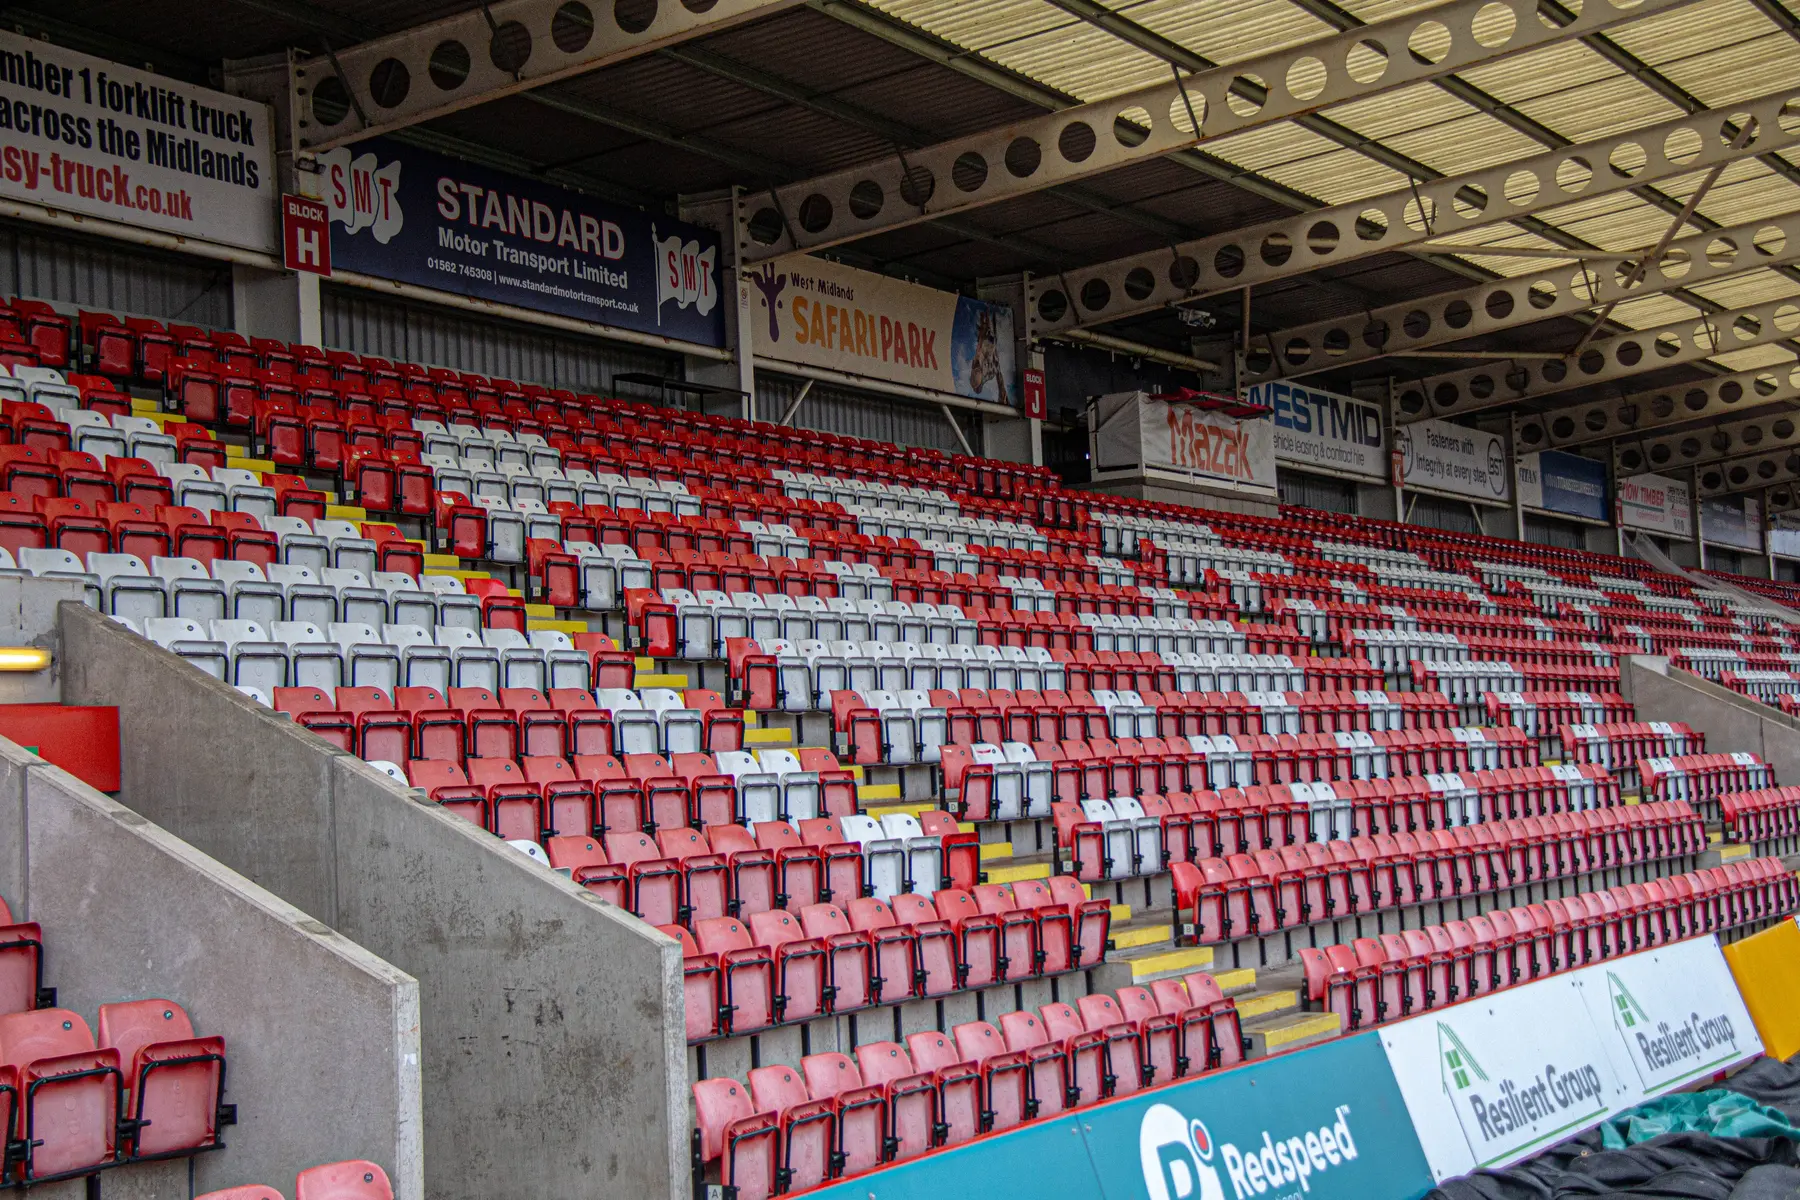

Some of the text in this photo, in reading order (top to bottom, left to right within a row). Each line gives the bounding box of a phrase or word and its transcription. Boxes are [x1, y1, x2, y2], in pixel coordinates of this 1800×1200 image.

[79, 67, 92, 104] 1
[97, 72, 186, 130] forklift
[190, 100, 254, 146] truck
[0, 96, 260, 189] across the Midlands
[0, 145, 193, 220] sy-truck.co.uk
[331, 164, 392, 220] SMT
[289, 202, 324, 222] BLOCK
[436, 176, 625, 260] STANDARD
[298, 227, 320, 267] H
[438, 226, 628, 290] Motor Transport Limited
[668, 250, 710, 296] SMT
[428, 257, 456, 274] 01562
[459, 264, 492, 281] 745308
[498, 274, 639, 314] www.standardmotortransport.co.uk
[791, 272, 854, 301] West Midlands
[792, 296, 938, 371] SAFARI PARK
[1032, 390, 1040, 414] J
[1274, 433, 1294, 452] ehicle
[1295, 436, 1318, 461] leasing
[1416, 452, 1445, 478] Integrity
[1446, 462, 1452, 476] at
[1454, 465, 1472, 484] every
[1474, 467, 1487, 488] step
[1426, 428, 1474, 456] Fasteners with
[1640, 486, 1664, 507] TIMBER
[1636, 1012, 1735, 1072] Resilient Group
[1469, 1063, 1602, 1142] Resilient Group
[1220, 1106, 1359, 1200] Redspeed
